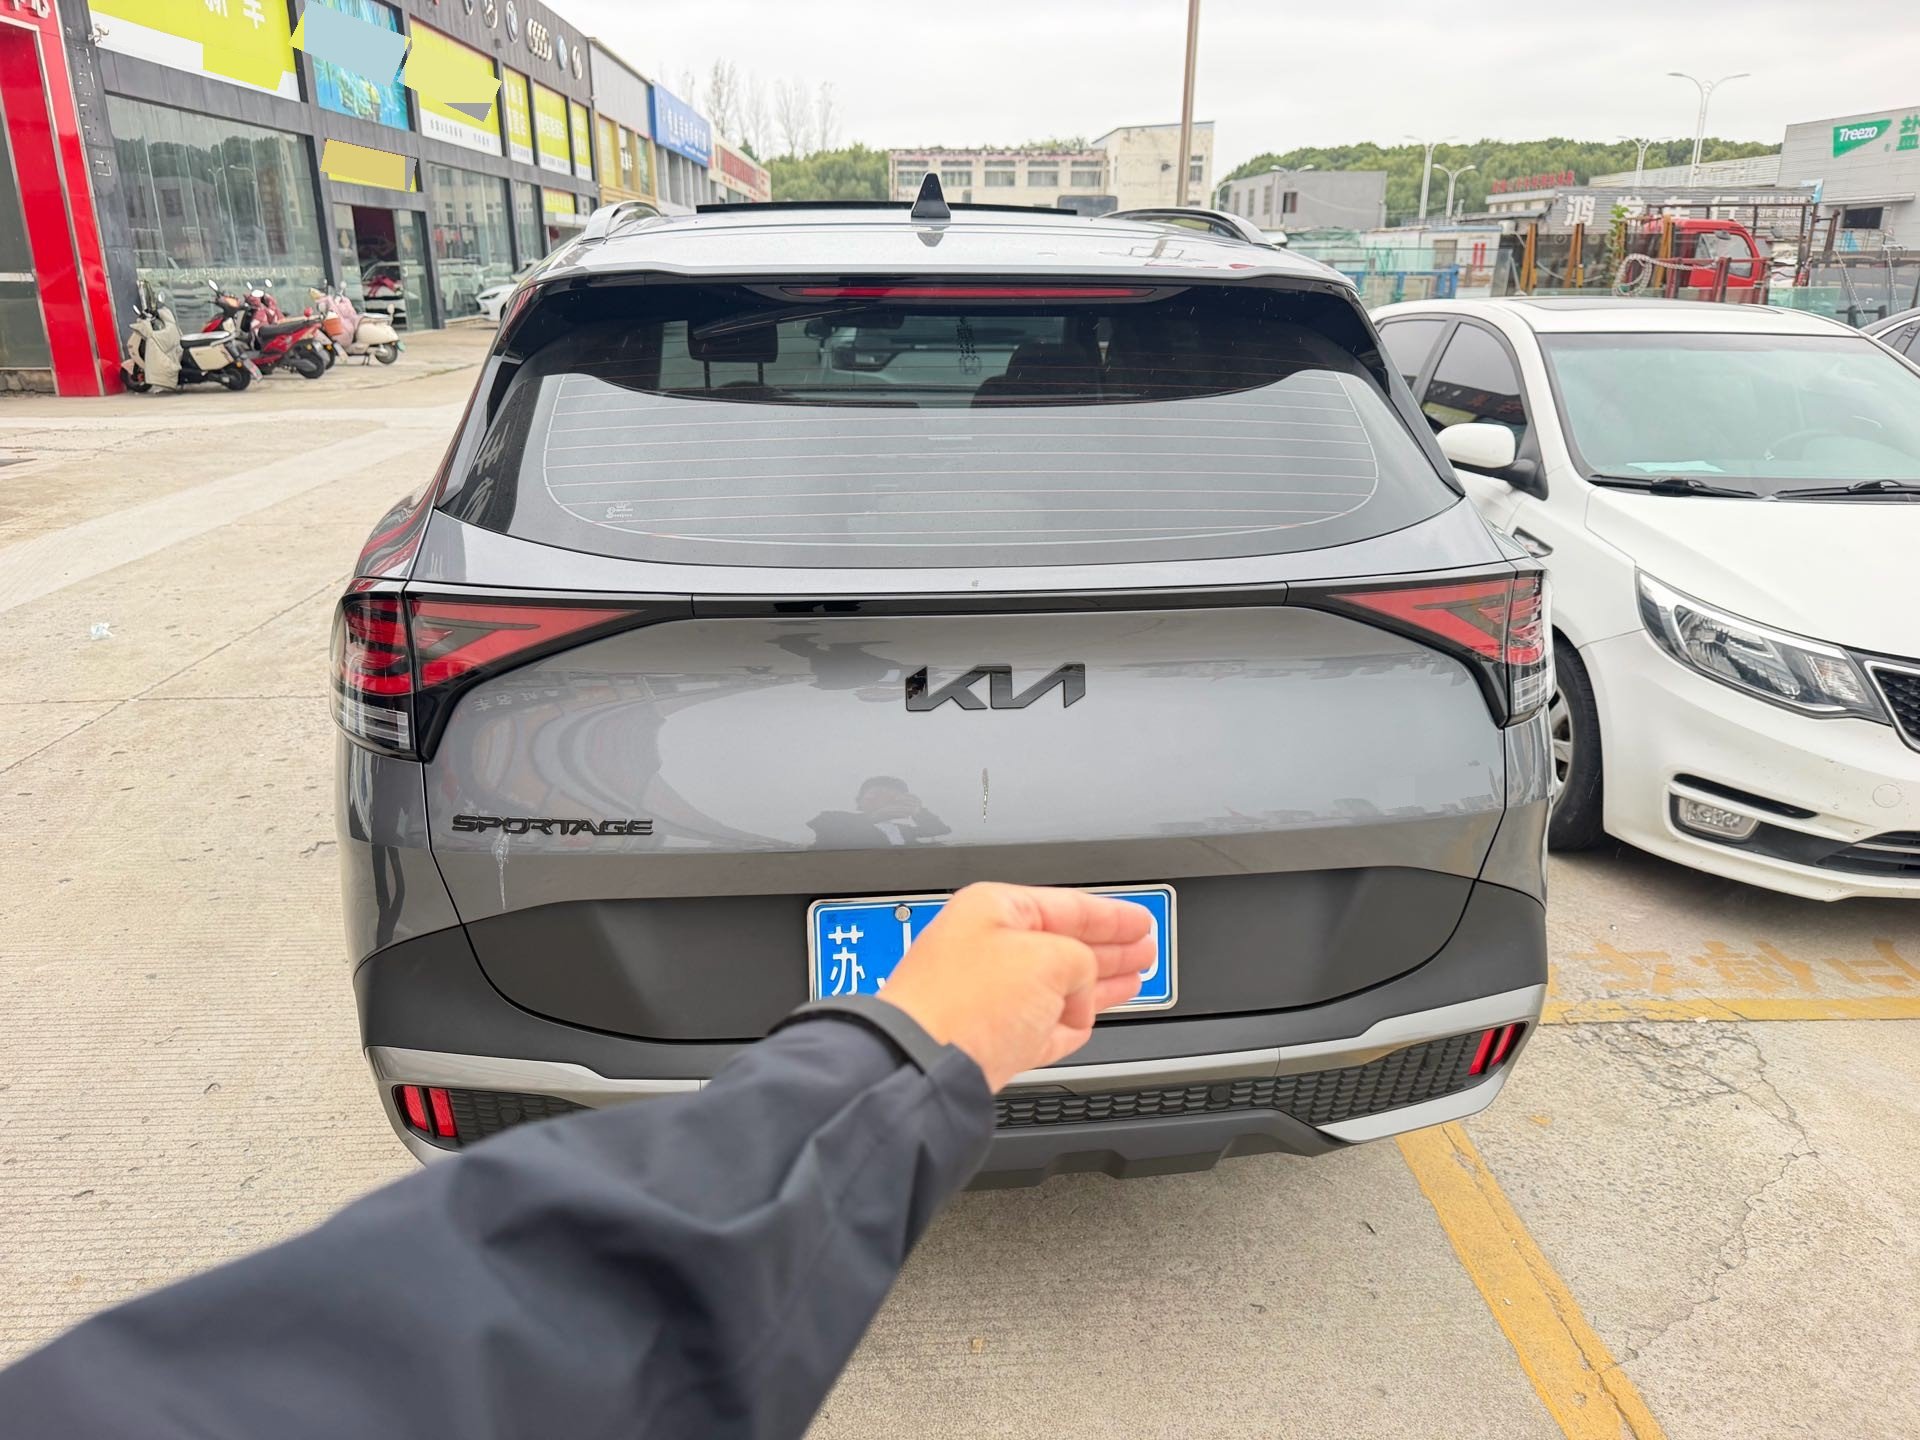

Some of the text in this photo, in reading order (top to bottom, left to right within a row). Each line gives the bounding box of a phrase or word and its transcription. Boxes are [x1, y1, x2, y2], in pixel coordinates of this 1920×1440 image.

[1839, 126, 1878, 142] Treezo
[905, 662, 1087, 712] KIA
[452, 814, 654, 835] SPORTAGE
